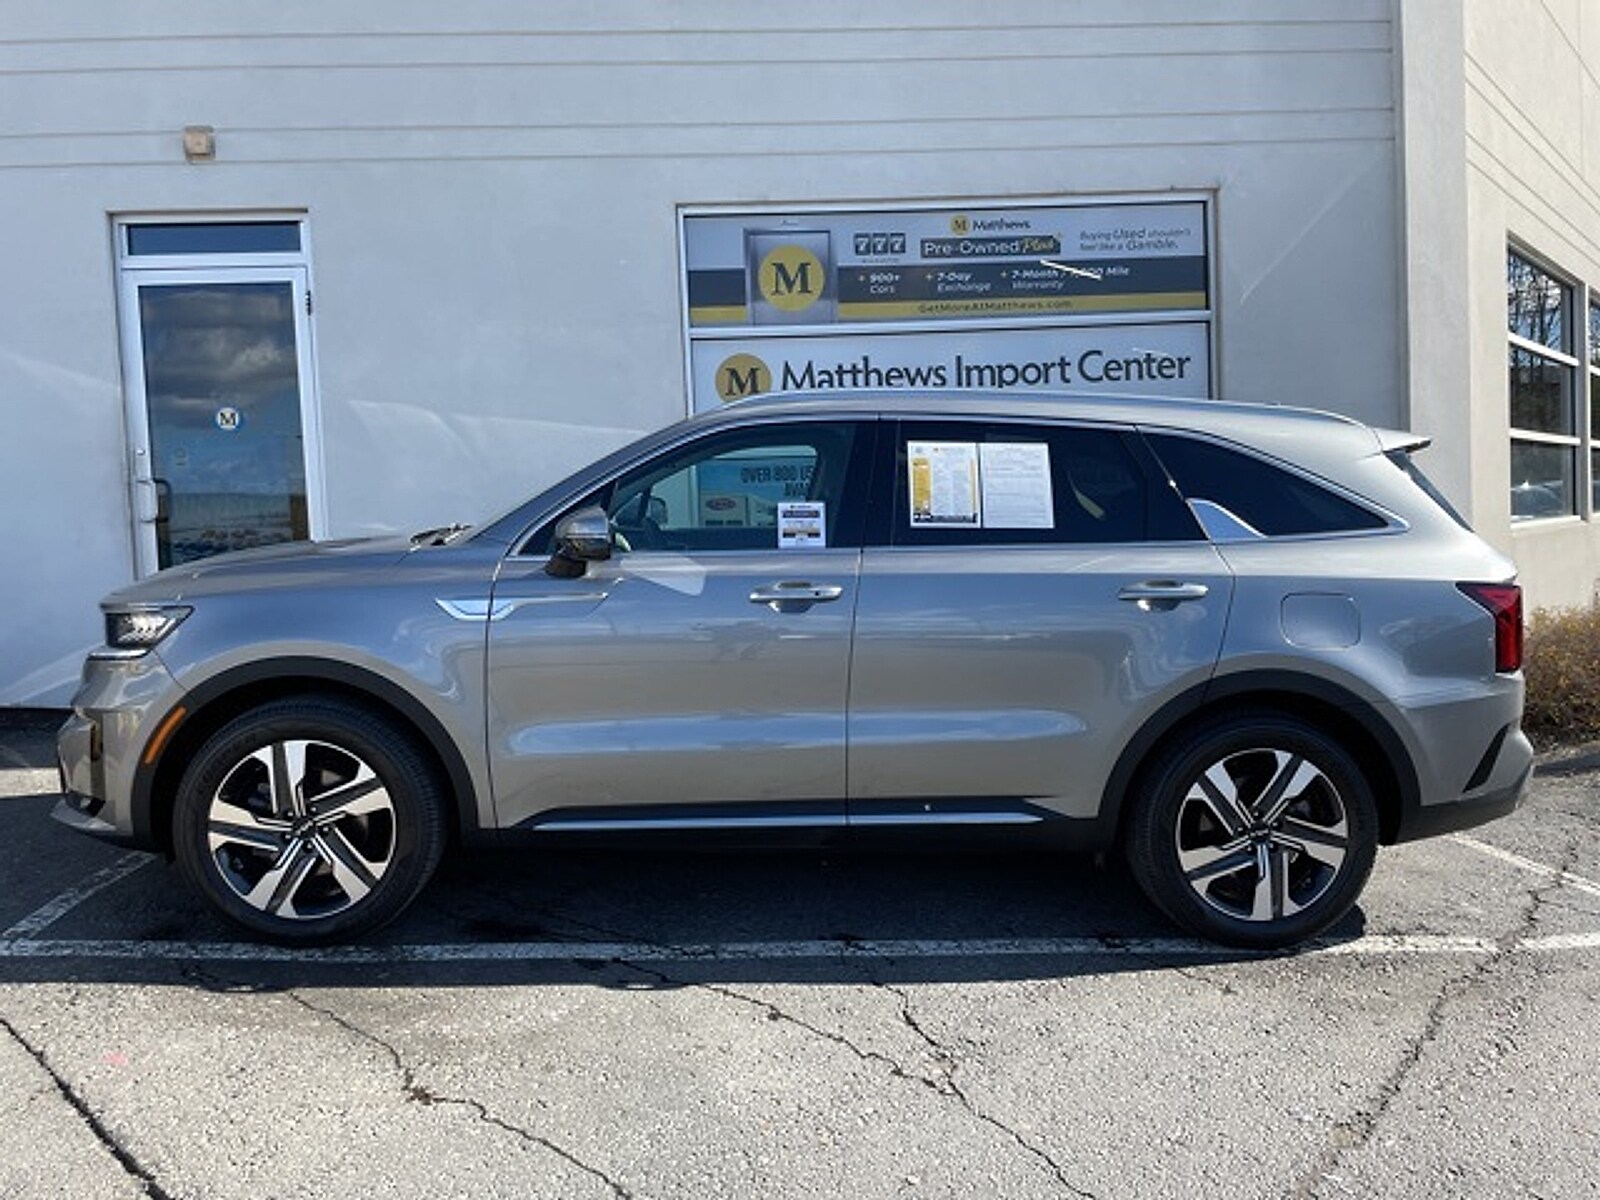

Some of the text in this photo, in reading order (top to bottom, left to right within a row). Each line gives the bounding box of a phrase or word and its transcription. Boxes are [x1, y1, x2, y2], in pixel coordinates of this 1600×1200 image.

[972, 218, 1031, 231] Matthews
[1113, 227, 1146, 240] Used
[857, 236, 904, 252] 777
[772, 262, 812, 295] M
[937, 272, 972, 282] 7-Day
[1012, 270, 1059, 280] 7-Month
[869, 285, 896, 294] Cars
[937, 282, 991, 292] Exchange
[1012, 279, 1065, 291] Warranty
[919, 299, 1072, 313] GetMoreAtMatthews.com
[782, 350, 1191, 391] Matthews Import Center
[724, 367, 760, 397] M
[219, 412, 236, 426] M
